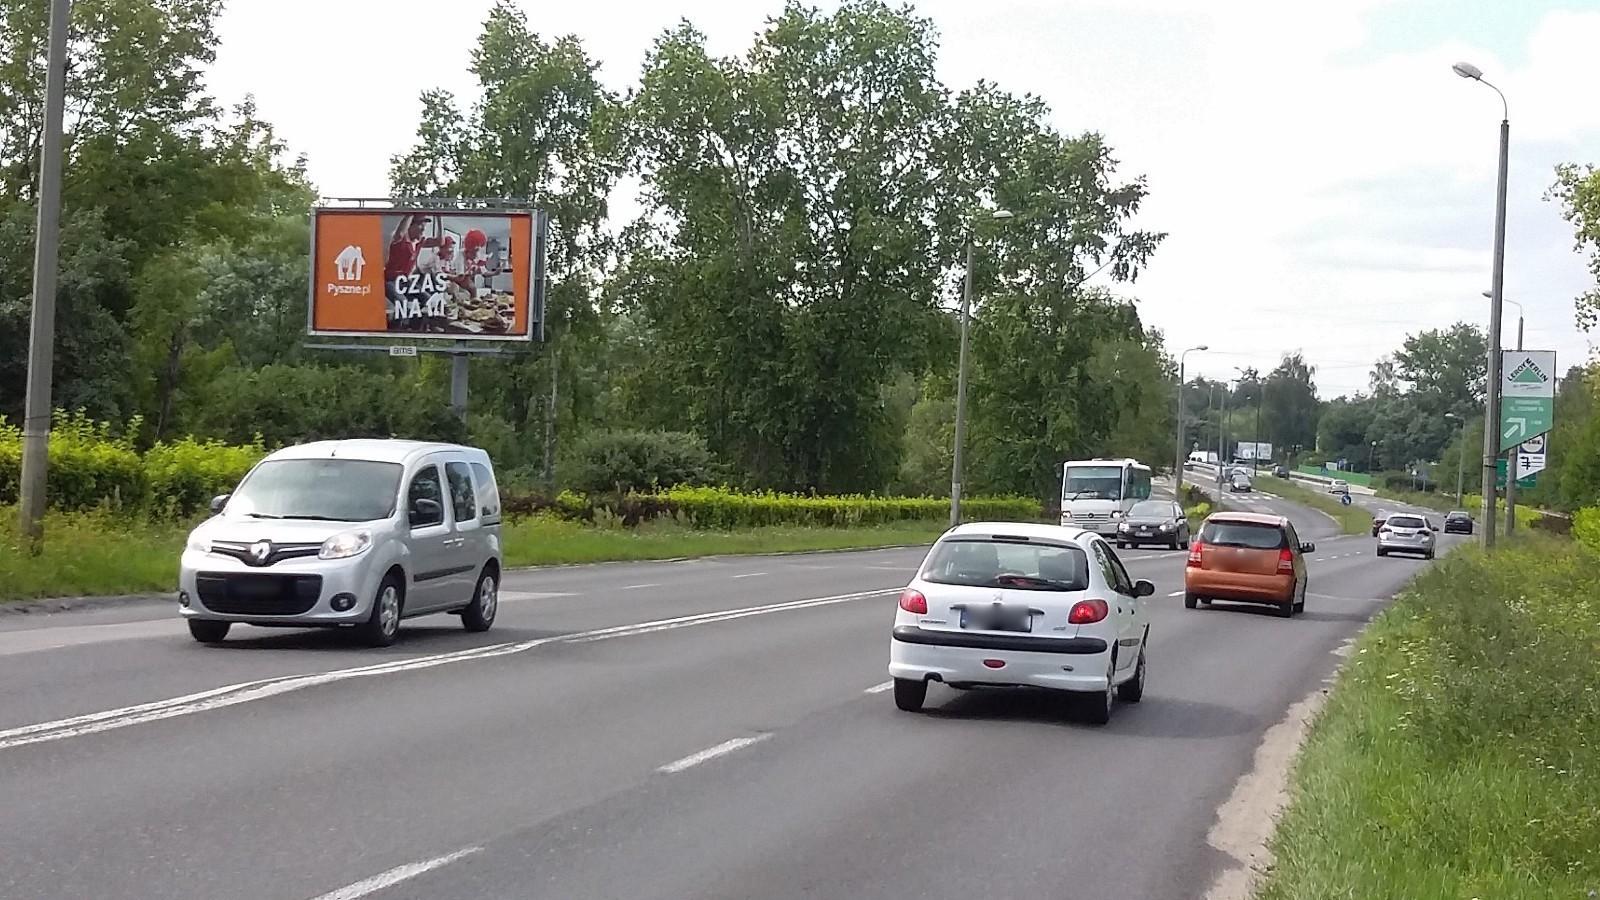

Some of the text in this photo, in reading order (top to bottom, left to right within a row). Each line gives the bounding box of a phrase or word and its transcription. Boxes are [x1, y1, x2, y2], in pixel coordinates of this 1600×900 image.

[327, 283, 371, 296] Pyszne.pl
[395, 272, 448, 295] CZAS
[394, 298, 422, 319] NA
[1507, 357, 1548, 382] LEROY MERLIN
